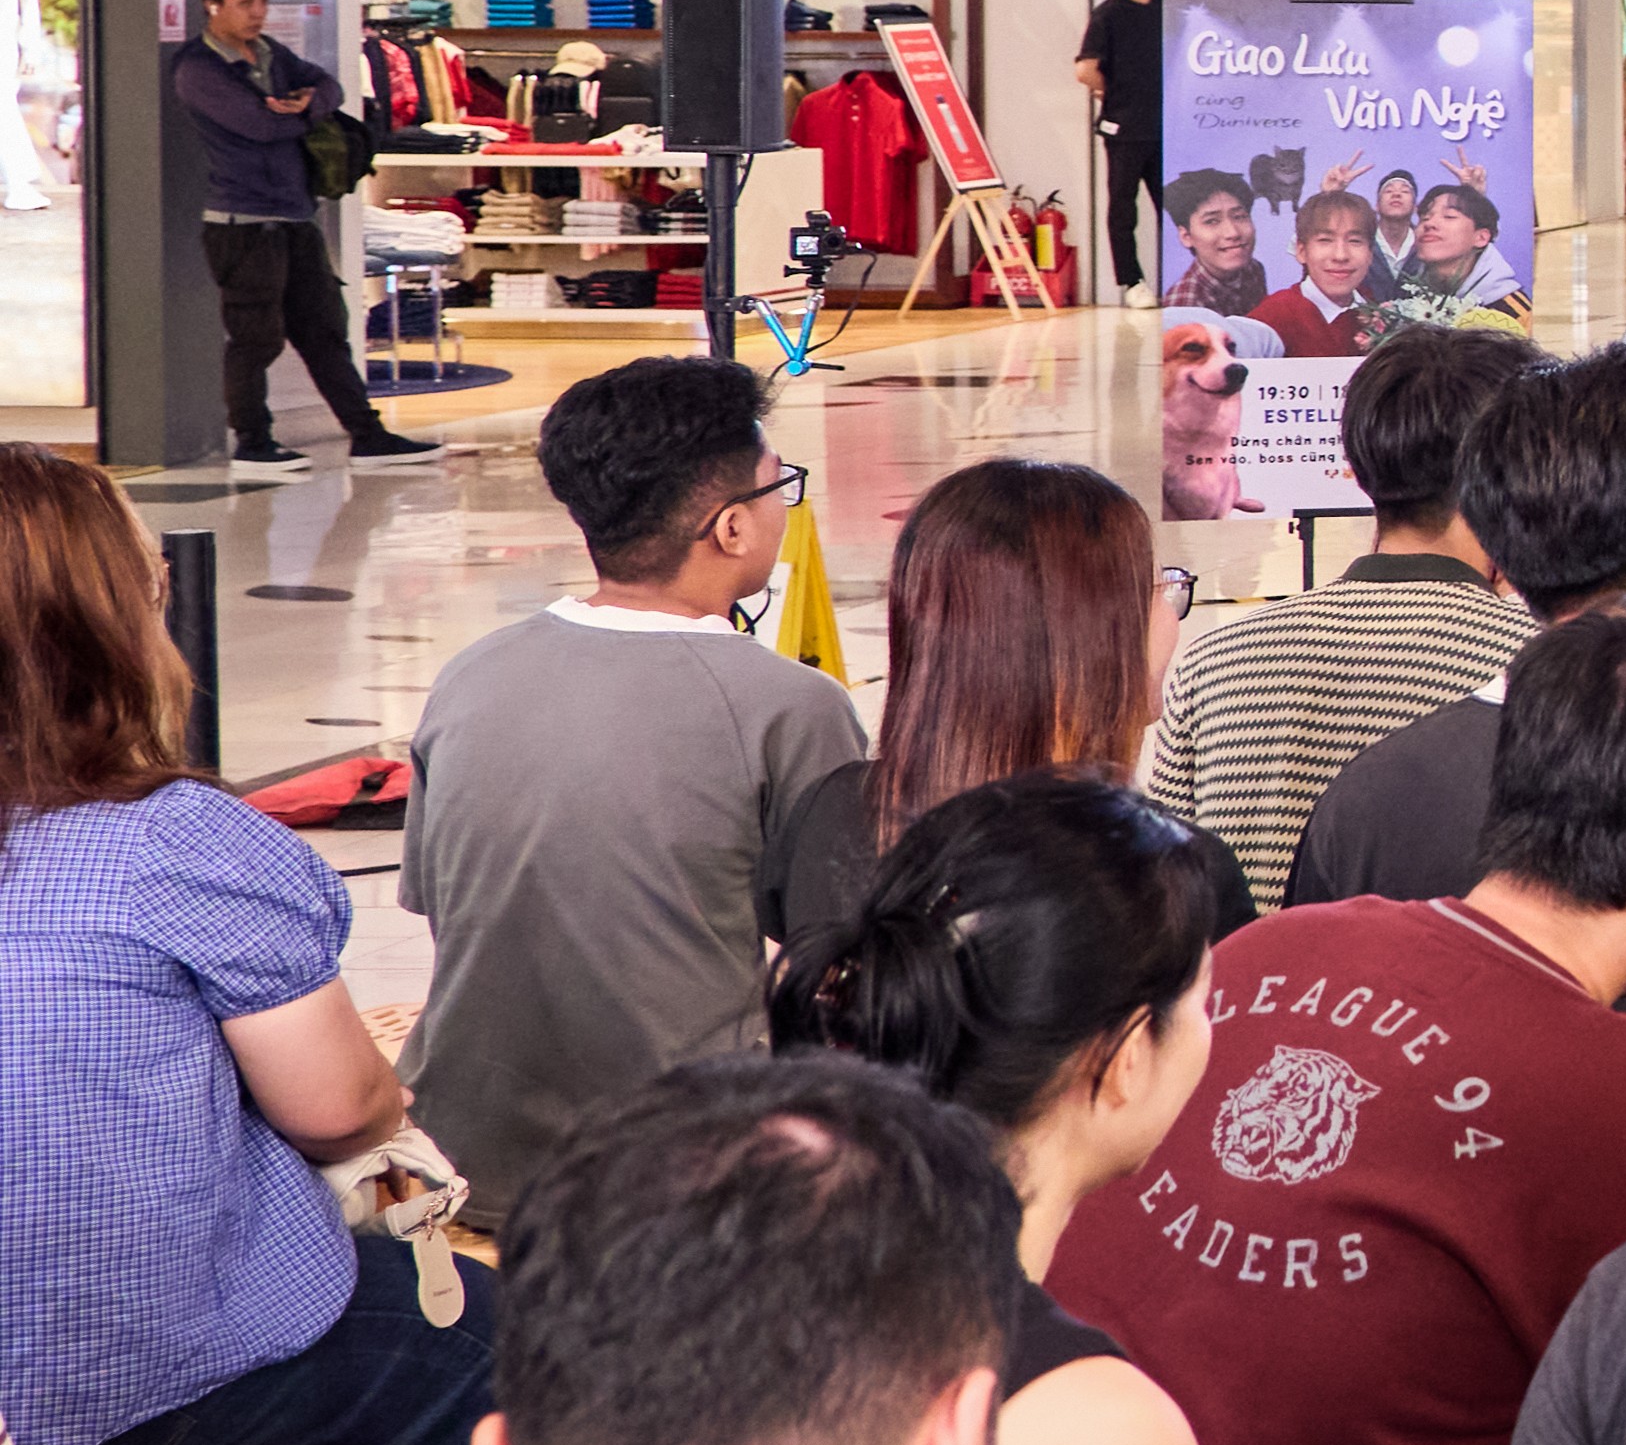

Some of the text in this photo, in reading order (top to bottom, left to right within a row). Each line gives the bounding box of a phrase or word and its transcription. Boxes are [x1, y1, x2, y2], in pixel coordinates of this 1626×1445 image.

[1187, 31, 1370, 77] Giao Lưu
[1325, 85, 1507, 142] Văn Nghệ
[1258, 386, 1309, 400] 19:30
[1264, 409, 1342, 423] ESTELL
[1276, 435, 1312, 446] chân
[1185, 455, 1213, 465] Sen
[1259, 453, 1294, 464] boss
[1300, 452, 1336, 464] cũng
[1209, 974, 1450, 1066] LEAGUE
[1138, 1168, 1369, 1289] EADERS
